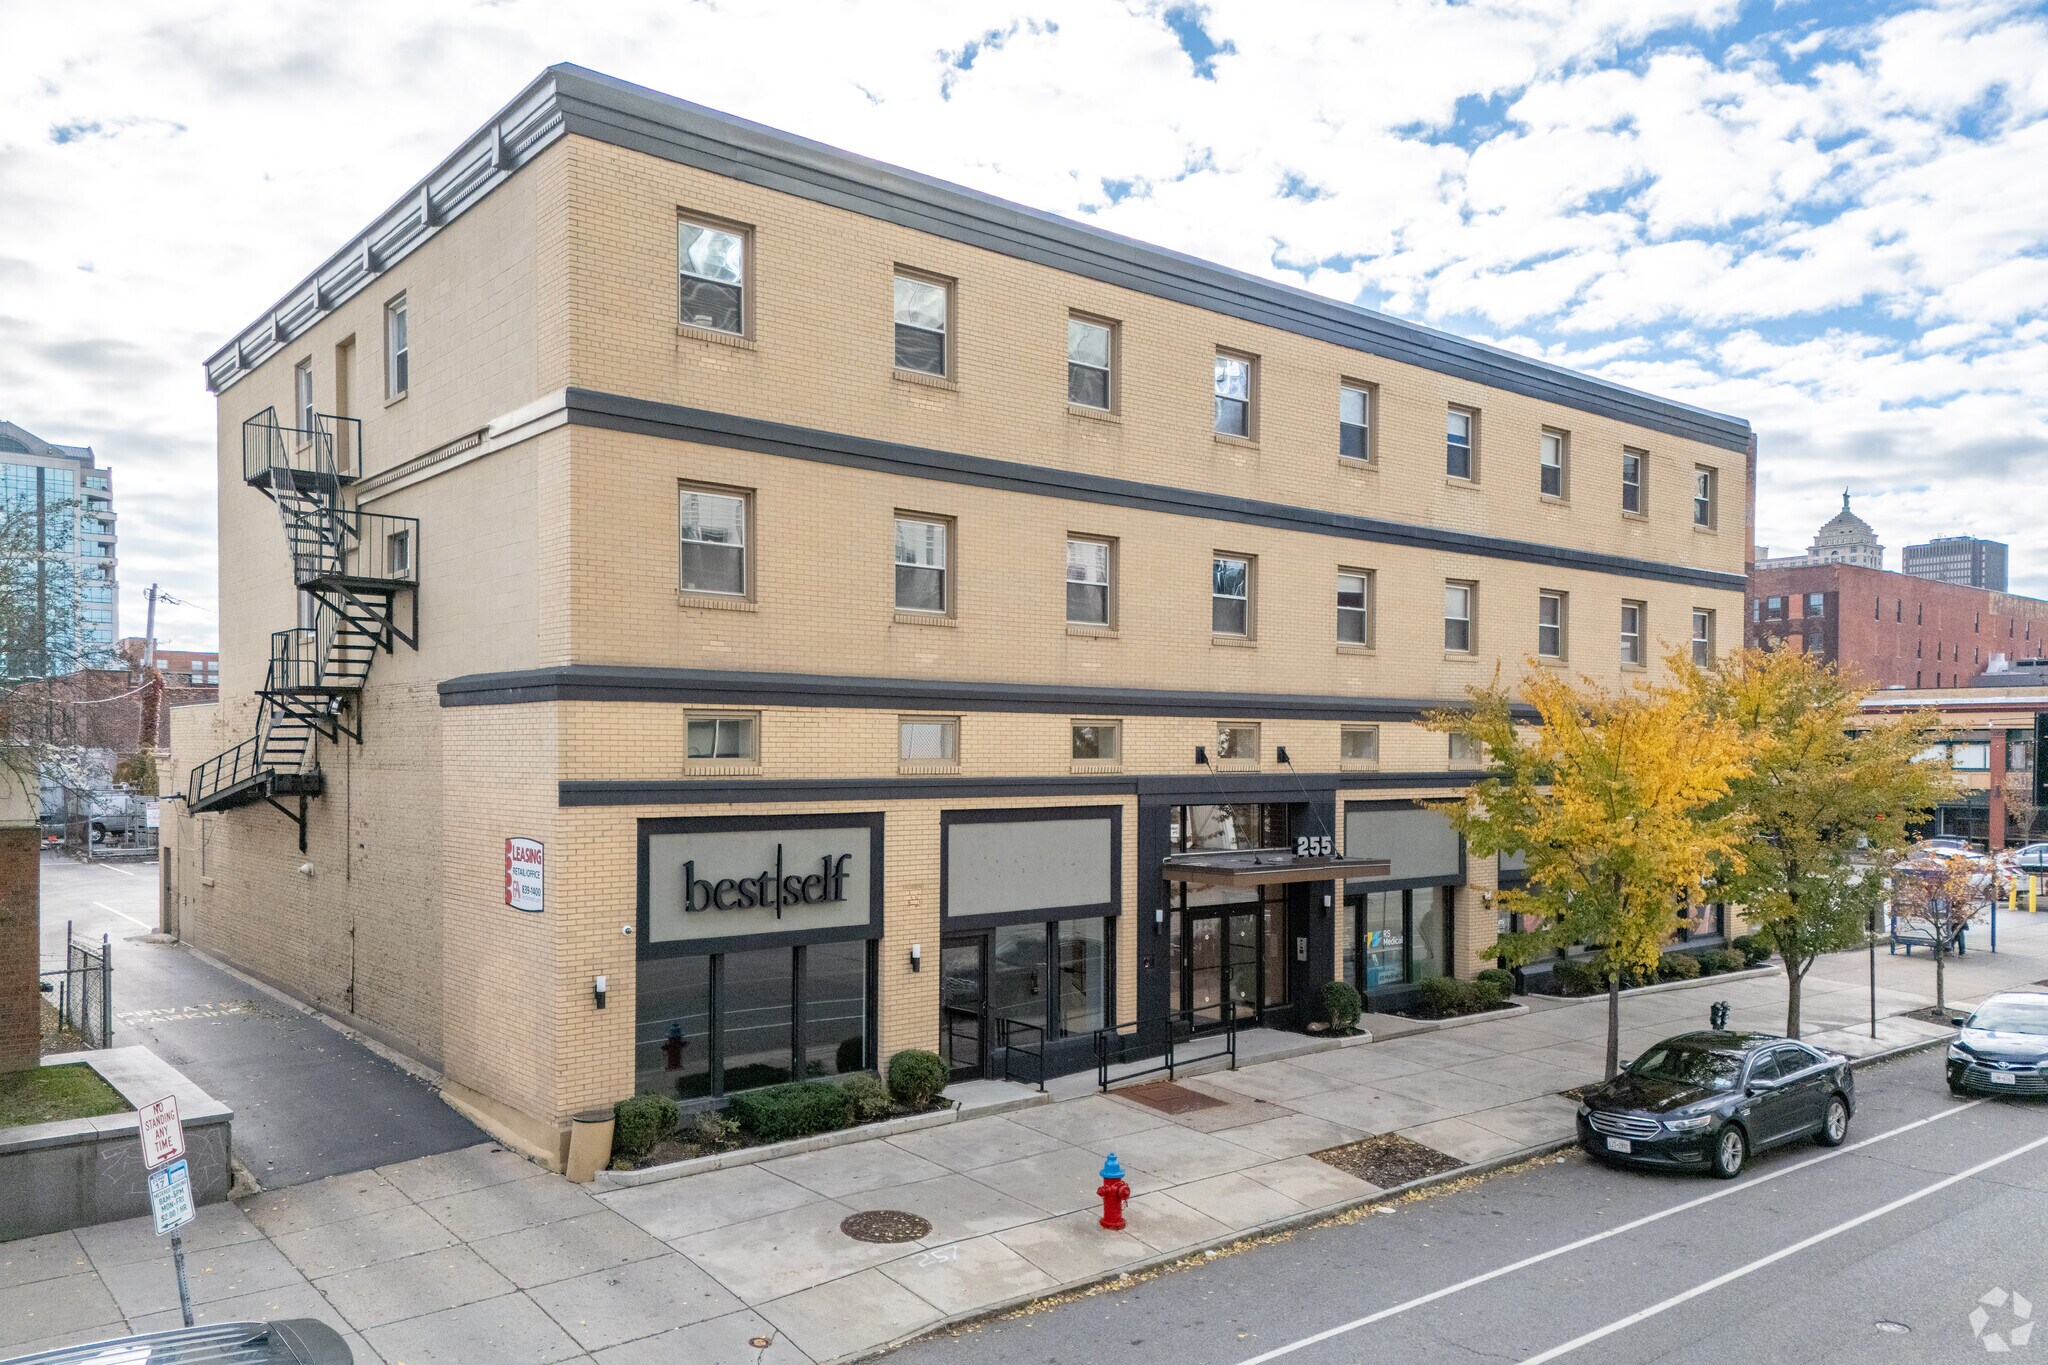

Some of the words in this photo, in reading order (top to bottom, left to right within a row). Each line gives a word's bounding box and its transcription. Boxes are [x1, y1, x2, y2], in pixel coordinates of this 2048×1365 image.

[1298, 836, 1331, 856] 255
[513, 845, 541, 865] LEASING
[1383, 929, 1391, 938] RS
[1383, 935, 1404, 946] Medical
[153, 1102, 164, 1115] NO
[145, 1110, 175, 1131] STANDING
[155, 1125, 168, 1140] ANY
[154, 1136, 173, 1152] TIME
[155, 1180, 165, 1189] 17
[911, 1245, 957, 1267] 257
